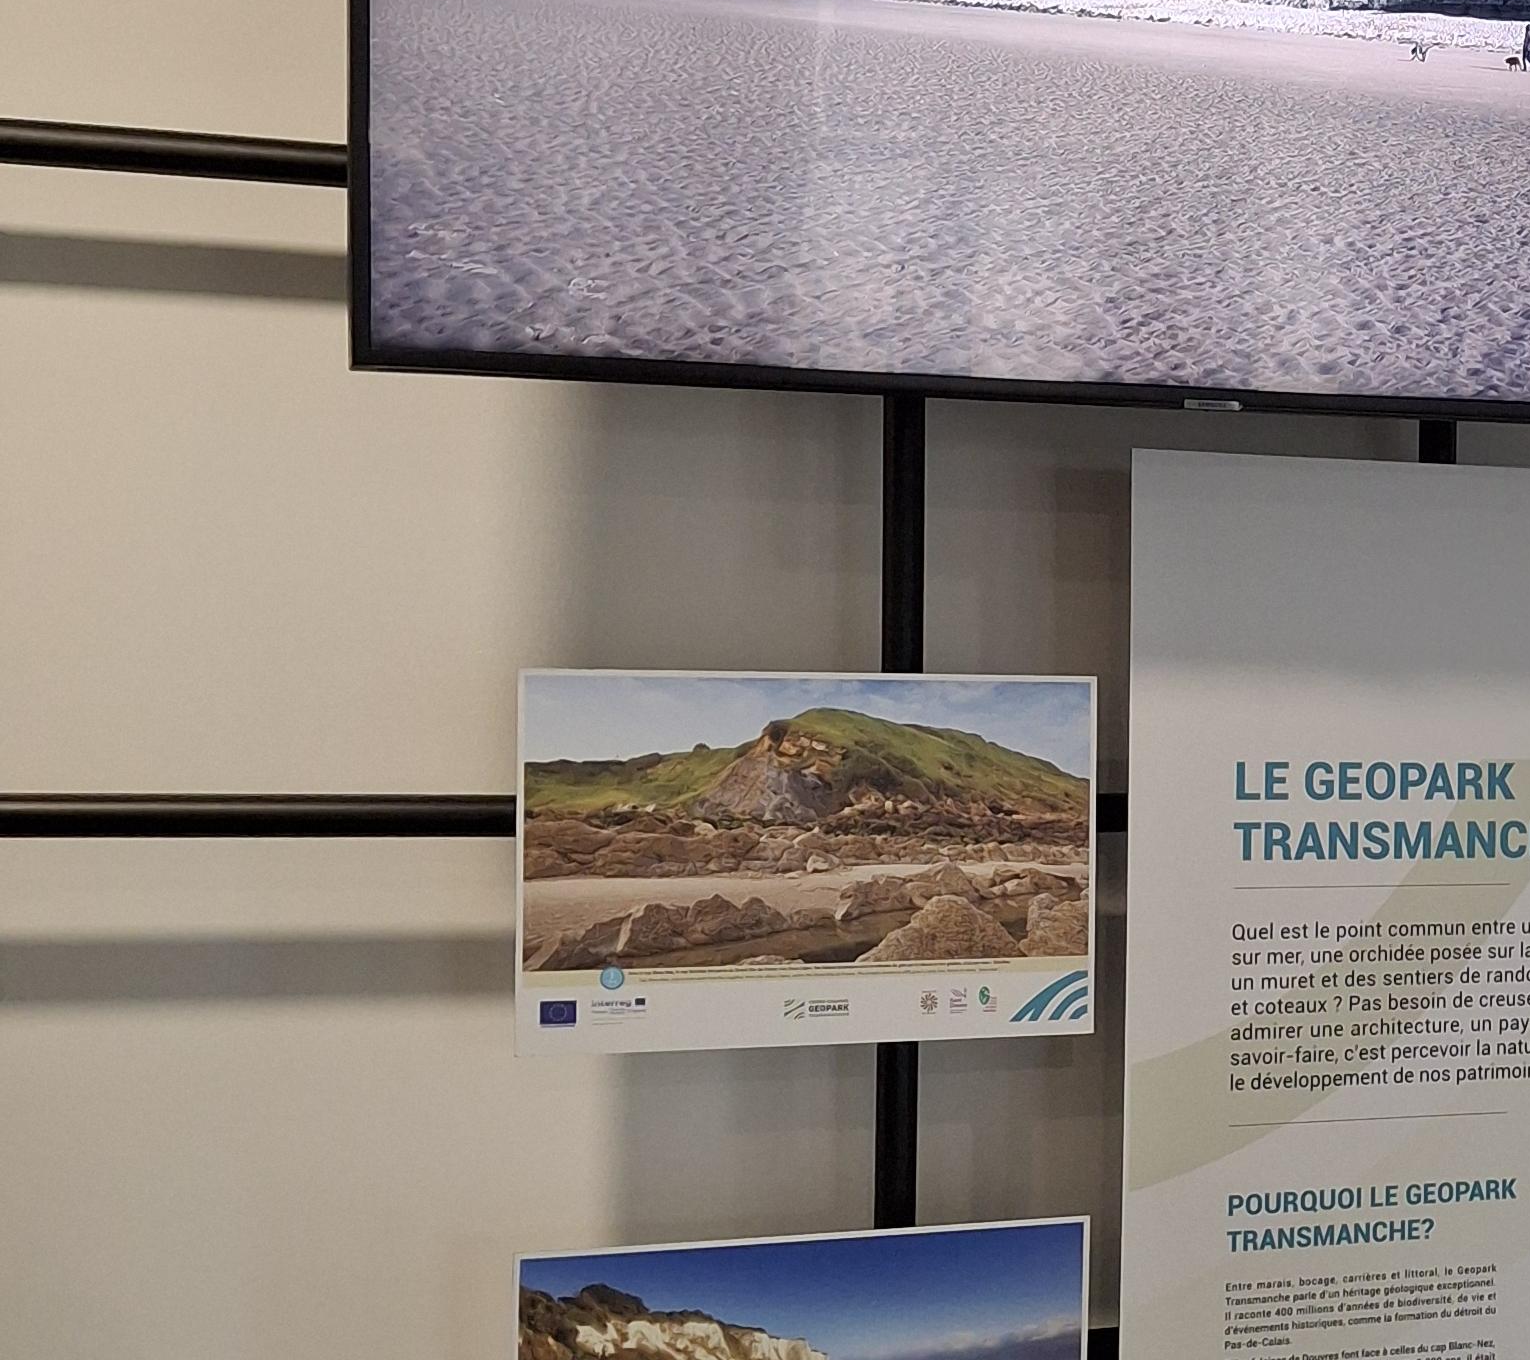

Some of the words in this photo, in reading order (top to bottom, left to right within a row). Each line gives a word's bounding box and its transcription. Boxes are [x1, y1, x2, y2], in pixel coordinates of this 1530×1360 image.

[1235, 761, 1290, 801] LE
[1304, 761, 1515, 801] GEOPARK
[1232, 922, 1274, 942] Quel
[1280, 923, 1309, 940] est
[1315, 920, 1330, 939] le
[1336, 921, 1382, 943] point
[1388, 922, 1466, 937] commun
[1471, 919, 1516, 936] entre
[1231, 951, 1262, 966] sur
[1267, 951, 1305, 967] mer,
[1310, 950, 1344, 964] une
[1349, 943, 1425, 963] orchidée
[1430, 942, 1482, 965] posée
[1487, 945, 1515, 959] sur
[1231, 977, 1254, 991] un
[1261, 973, 1316, 990] muret
[1321, 972, 1338, 988] et
[1344, 969, 1376, 988] des
[1382, 969, 1454, 986] sentiers
[1459, 966, 1481, 984] de
[1230, 1045, 1339, 1067] savoir-faire,
[1344, 1044, 1386, 1062] c'est
[1391, 1043, 1471, 1064] percevoir
[1476, 1038, 1491, 1056] la
[1230, 1073, 1245, 1091] le
[1250, 1069, 1388, 1092] développement
[1393, 1066, 1415, 1084] de
[1419, 1068, 1451, 1083] nos
[1228, 1187, 1362, 1217] POURQUOI
[1370, 1185, 1399, 1208] LE
[1405, 1178, 1517, 1206] GEOPARK
[1226, 1217, 1435, 1253] TRANSMANCHE?
[1225, 1282, 1253, 1293] Entre
[1390, 1271, 1401, 1280] et
[1444, 1266, 1454, 1276] le
[1457, 1263, 1497, 1276] Geopark
[1319, 1289, 1341, 1300] d'un
